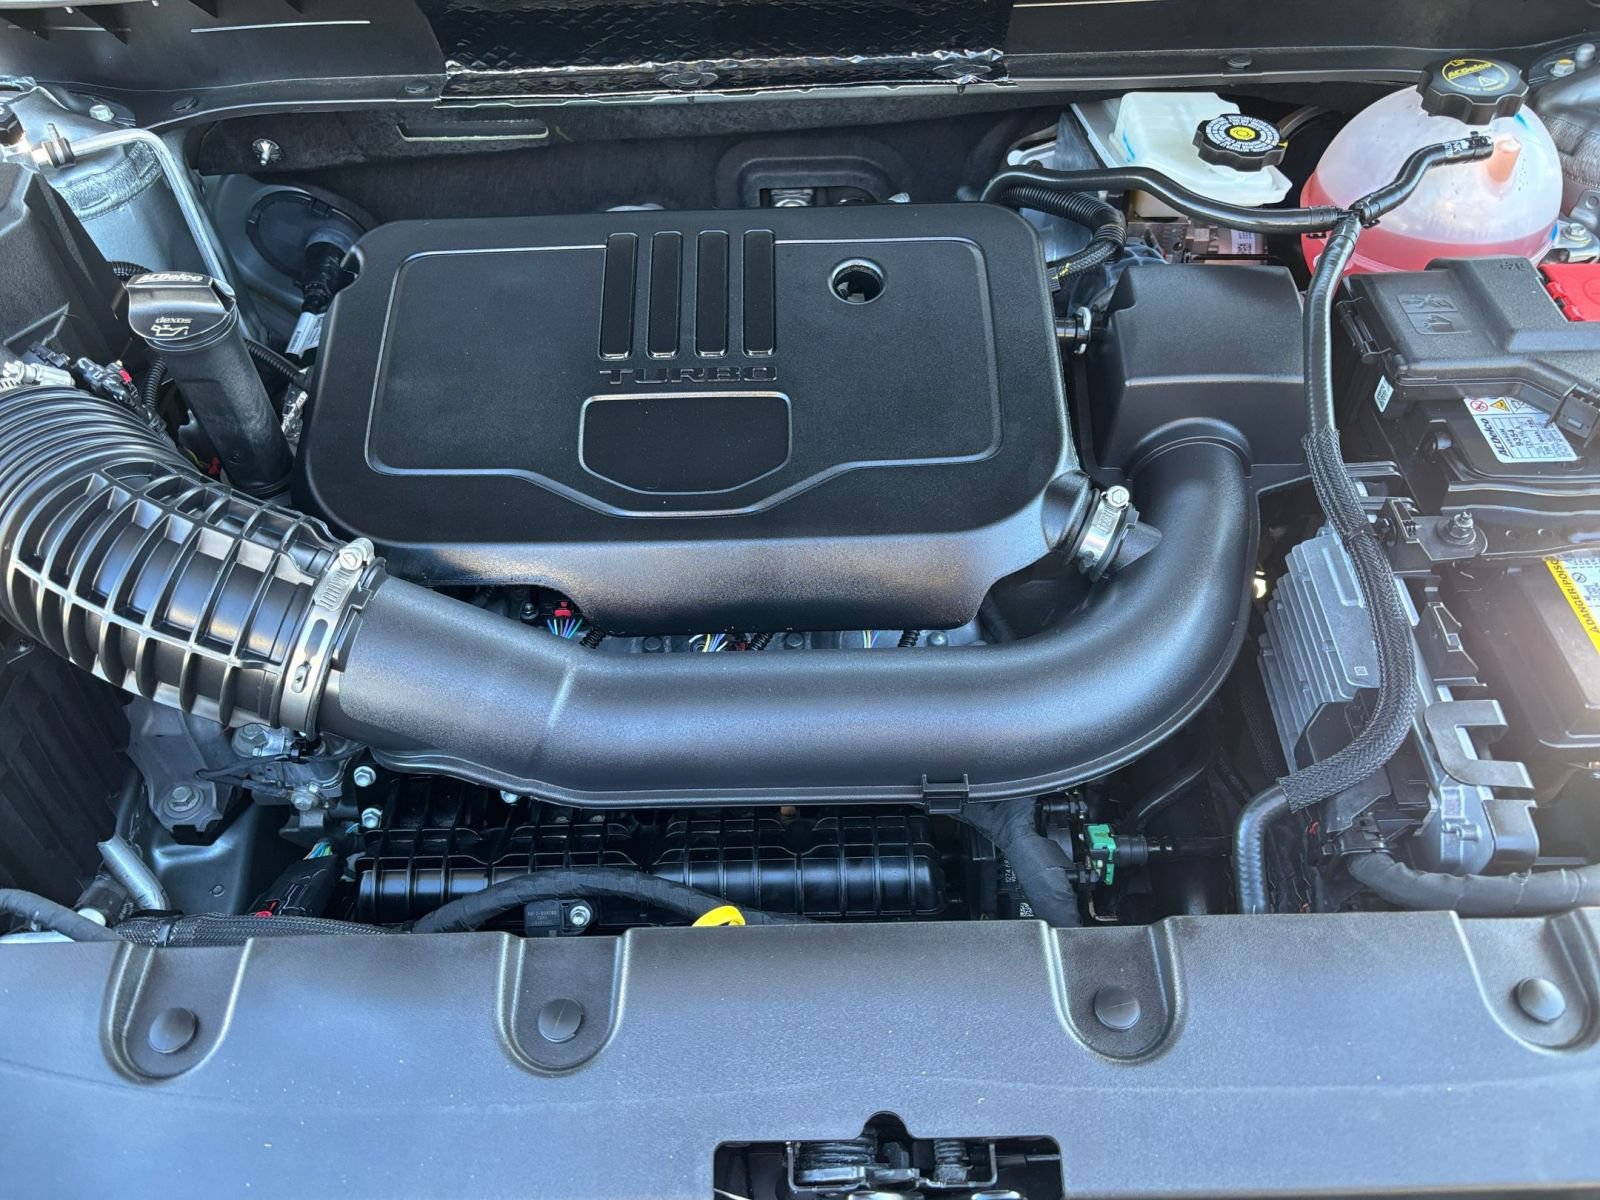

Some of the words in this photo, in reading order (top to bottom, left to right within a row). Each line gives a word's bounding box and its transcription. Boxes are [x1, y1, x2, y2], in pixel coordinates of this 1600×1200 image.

[134, 273, 204, 284] ACDelco
[155, 316, 193, 324] dexos
[599, 367, 777, 385] TURBO
[1481, 418, 1509, 457] ACDelco
